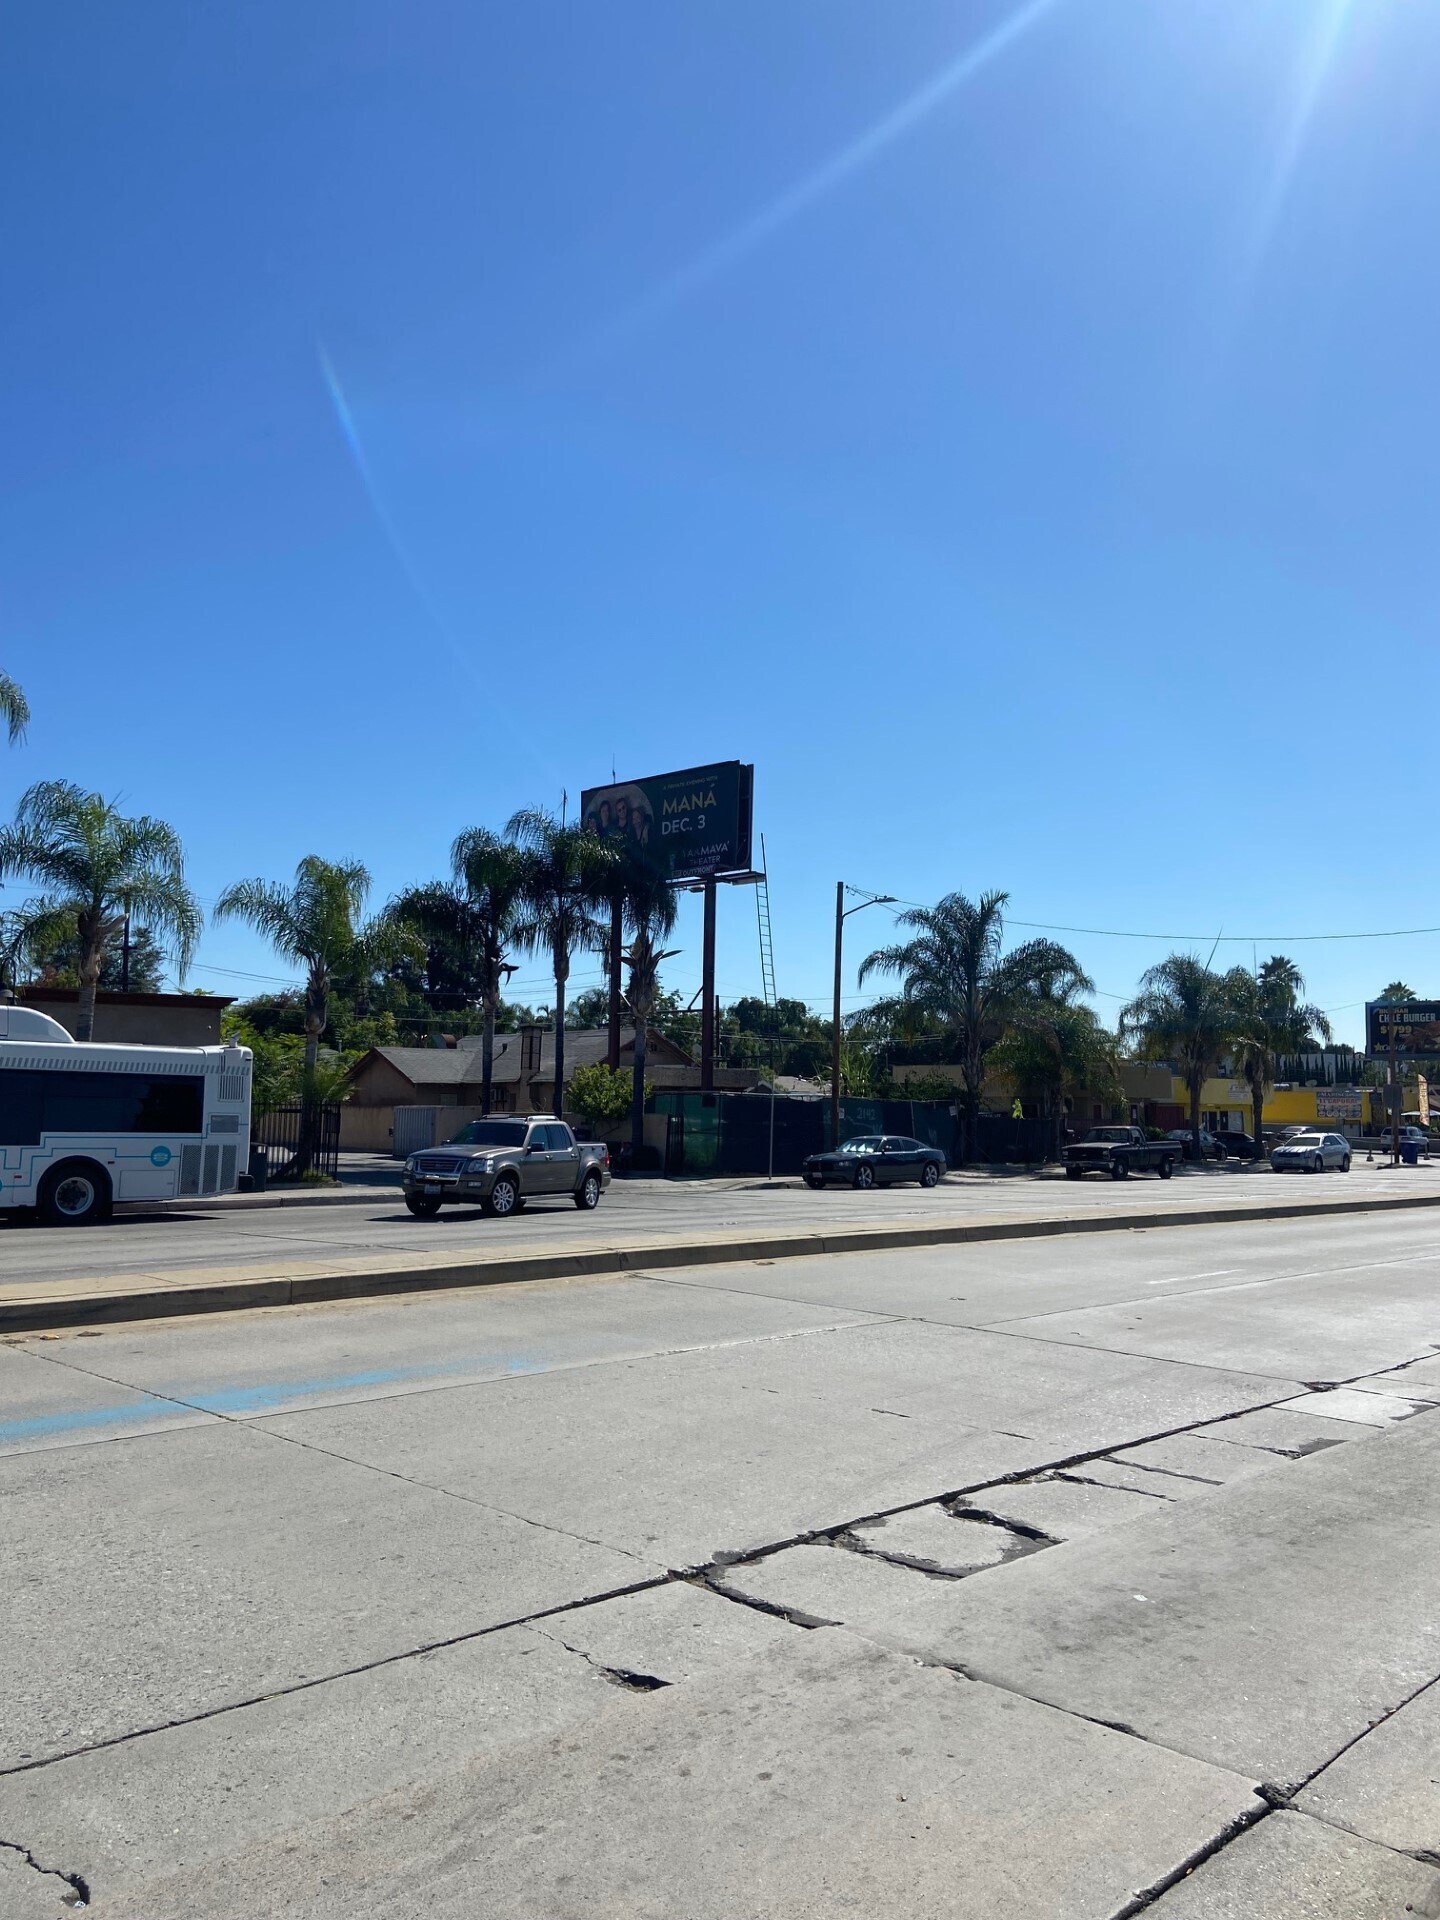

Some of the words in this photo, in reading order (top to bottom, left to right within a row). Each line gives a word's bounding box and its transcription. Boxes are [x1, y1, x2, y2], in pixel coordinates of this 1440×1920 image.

[662, 783, 717, 816] MANÁ
[661, 818, 693, 836] DEC.
[698, 814, 706, 829] 3
[689, 855, 720, 866] THEATER
[1378, 1014, 1401, 1023] CHLE
[1404, 1012, 1436, 1022] BURGER
